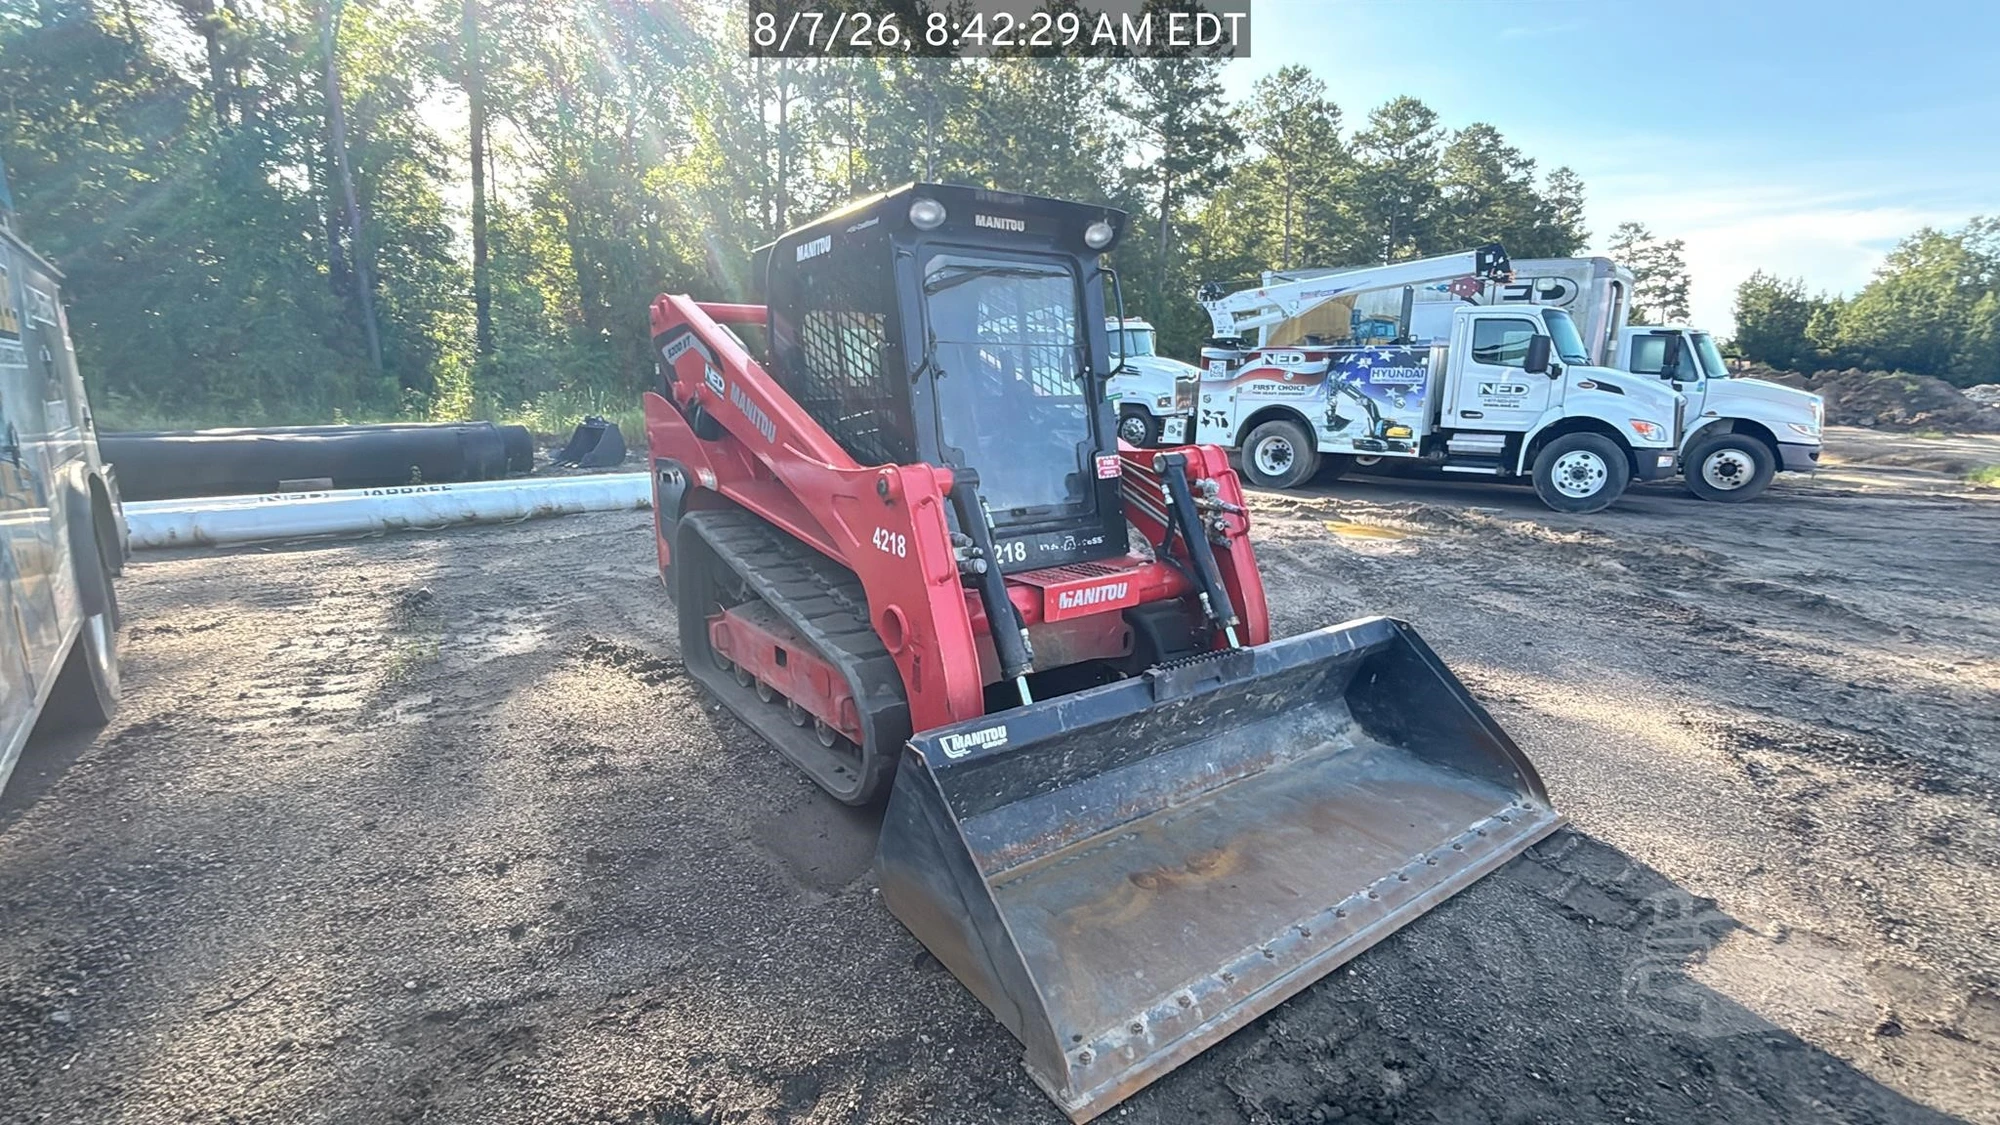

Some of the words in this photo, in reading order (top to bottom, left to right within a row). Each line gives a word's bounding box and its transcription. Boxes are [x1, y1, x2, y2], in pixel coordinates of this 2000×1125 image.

[975, 214, 1025, 232] MANITOU
[796, 234, 832, 262] MANITOU
[1261, 352, 1306, 366] NED
[705, 363, 726, 394] NED
[1371, 369, 1425, 379] HYUNDAI
[1252, 384, 1277, 392] FIRST
[1277, 385, 1306, 394] CHOICE
[1478, 383, 1530, 396] NED
[730, 381, 776, 445] MANITOU
[872, 527, 907, 559] 4218
[993, 541, 1027, 565] 218
[1058, 582, 1128, 611] MANITOU
[951, 725, 1007, 751] MANITOU
